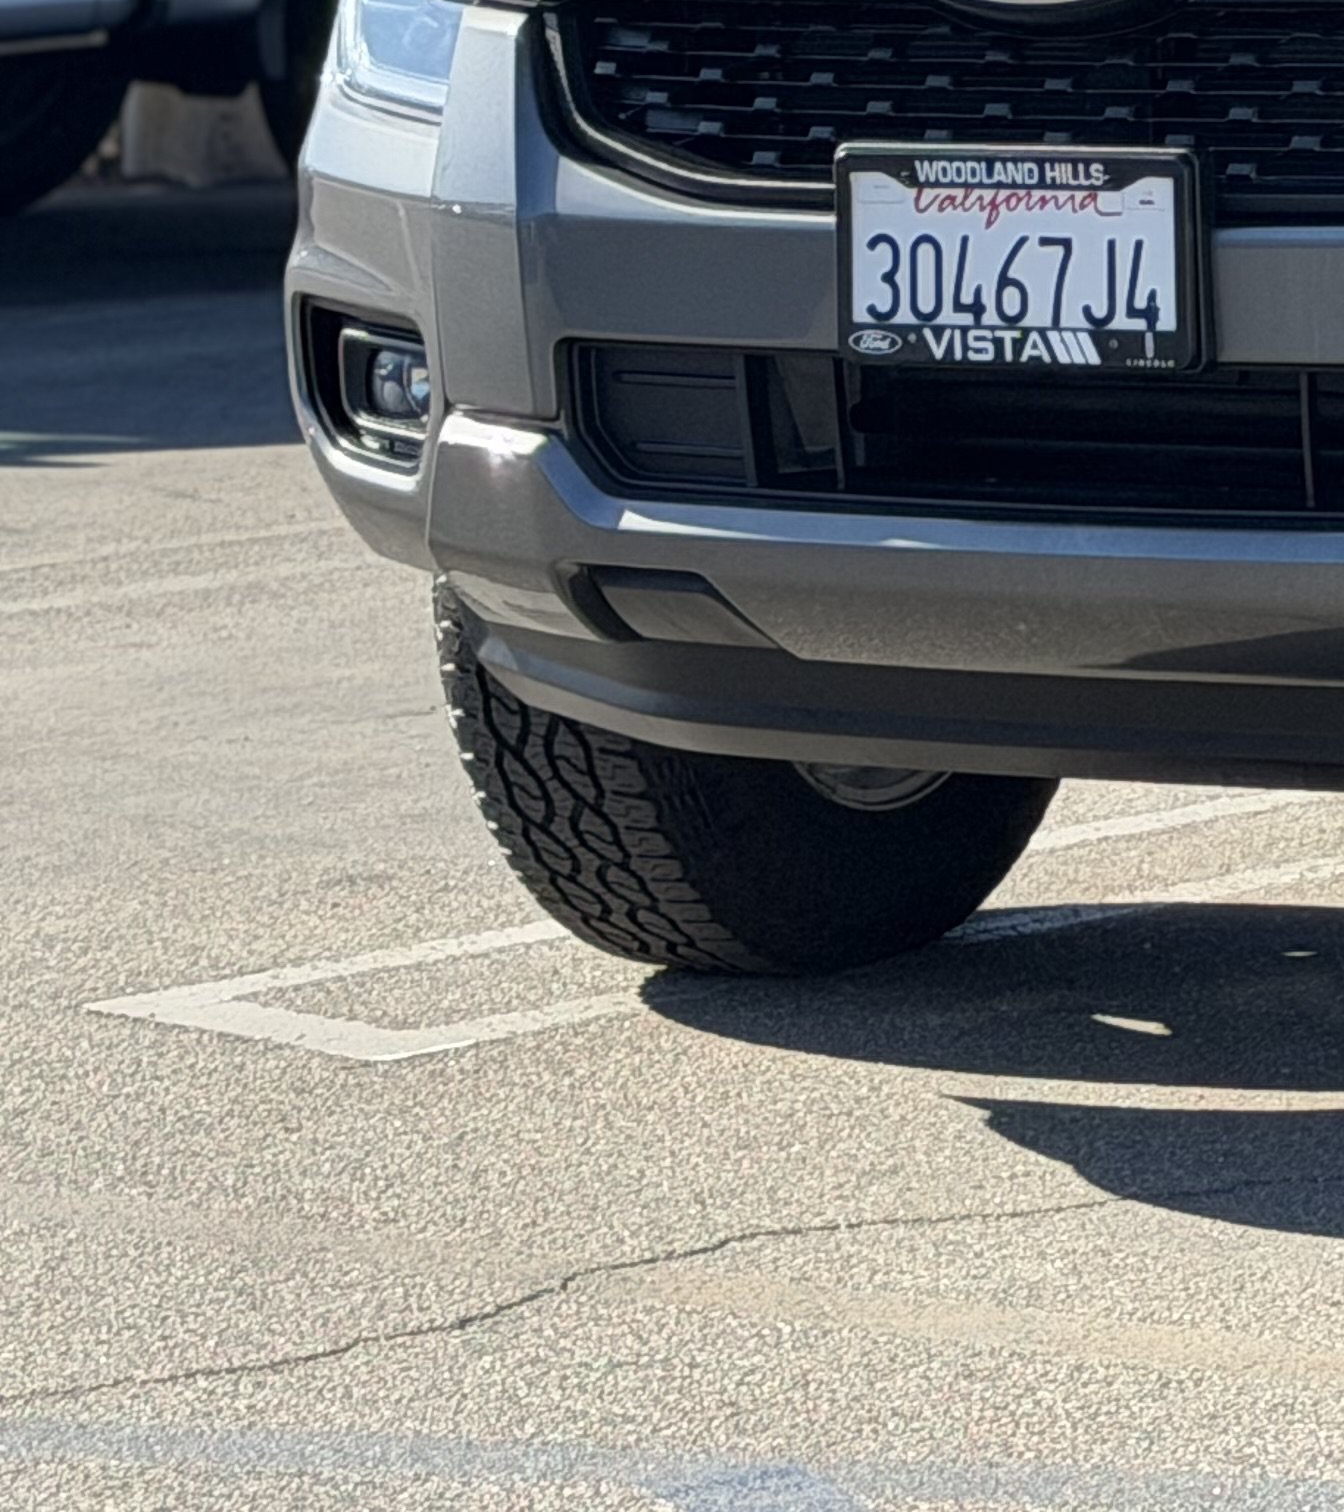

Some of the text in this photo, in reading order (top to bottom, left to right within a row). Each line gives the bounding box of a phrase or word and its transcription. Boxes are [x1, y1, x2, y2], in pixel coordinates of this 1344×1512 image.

[914, 160, 1104, 186] WOODLAND HILLS
[913, 187, 1123, 230] California
[865, 232, 1160, 330] 30467J4
[922, 327, 1052, 363] VISTA
